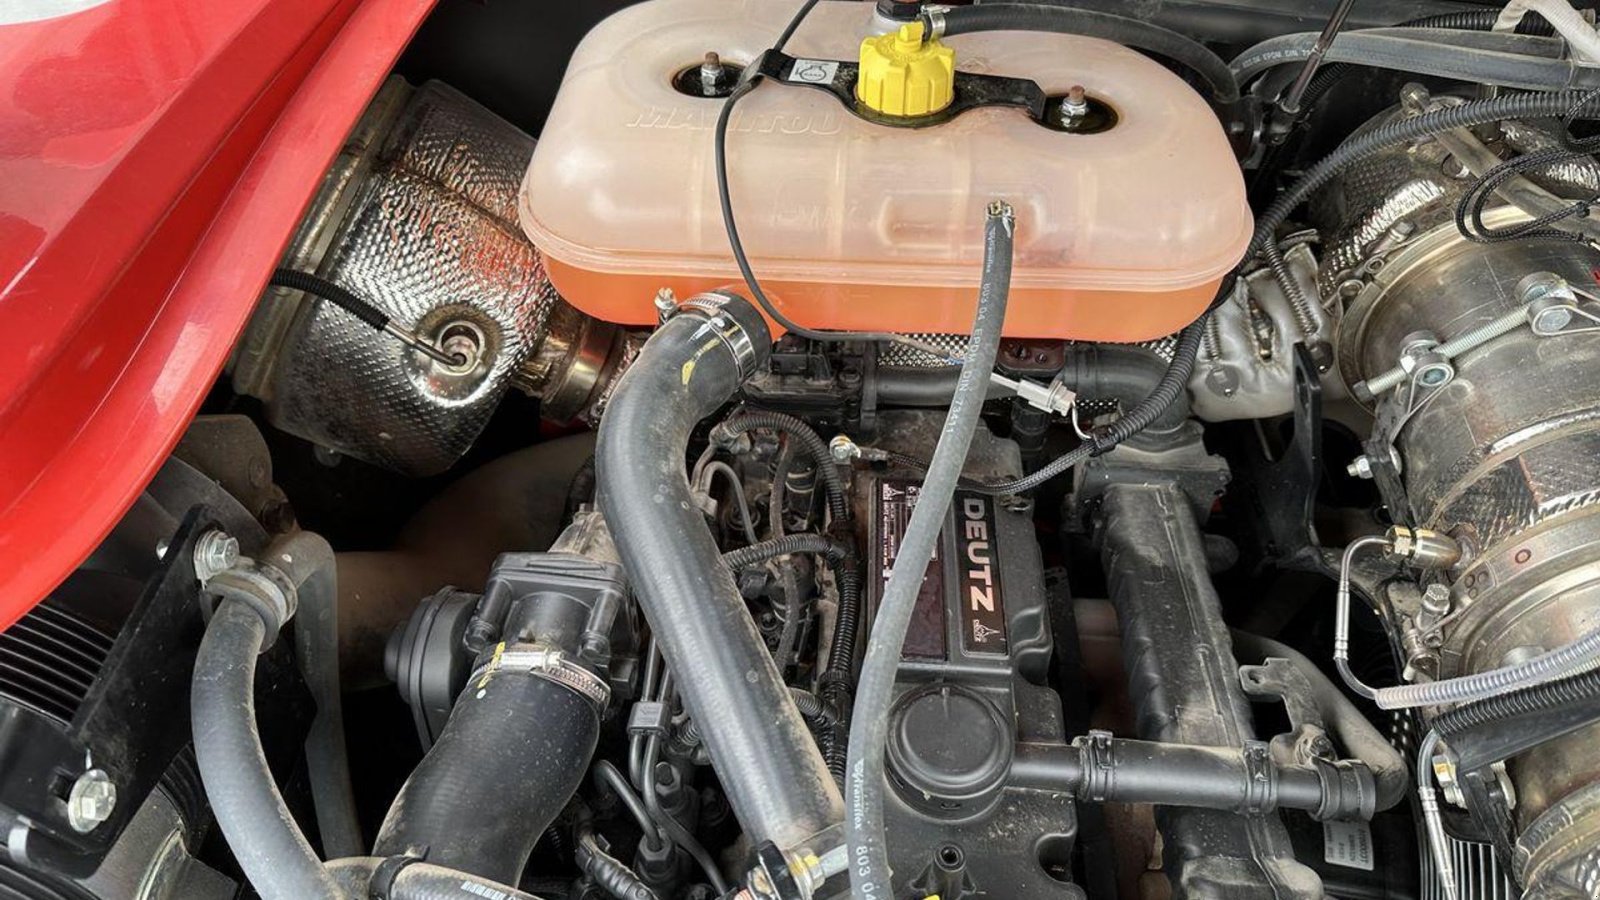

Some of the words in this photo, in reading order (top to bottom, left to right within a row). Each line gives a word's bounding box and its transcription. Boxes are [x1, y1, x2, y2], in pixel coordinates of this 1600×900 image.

[967, 328, 984, 363] EPDM
[959, 370, 973, 392] DIN
[945, 398, 964, 433] 73411
[964, 498, 994, 612] DEUTZ
[856, 846, 871, 877] 803
